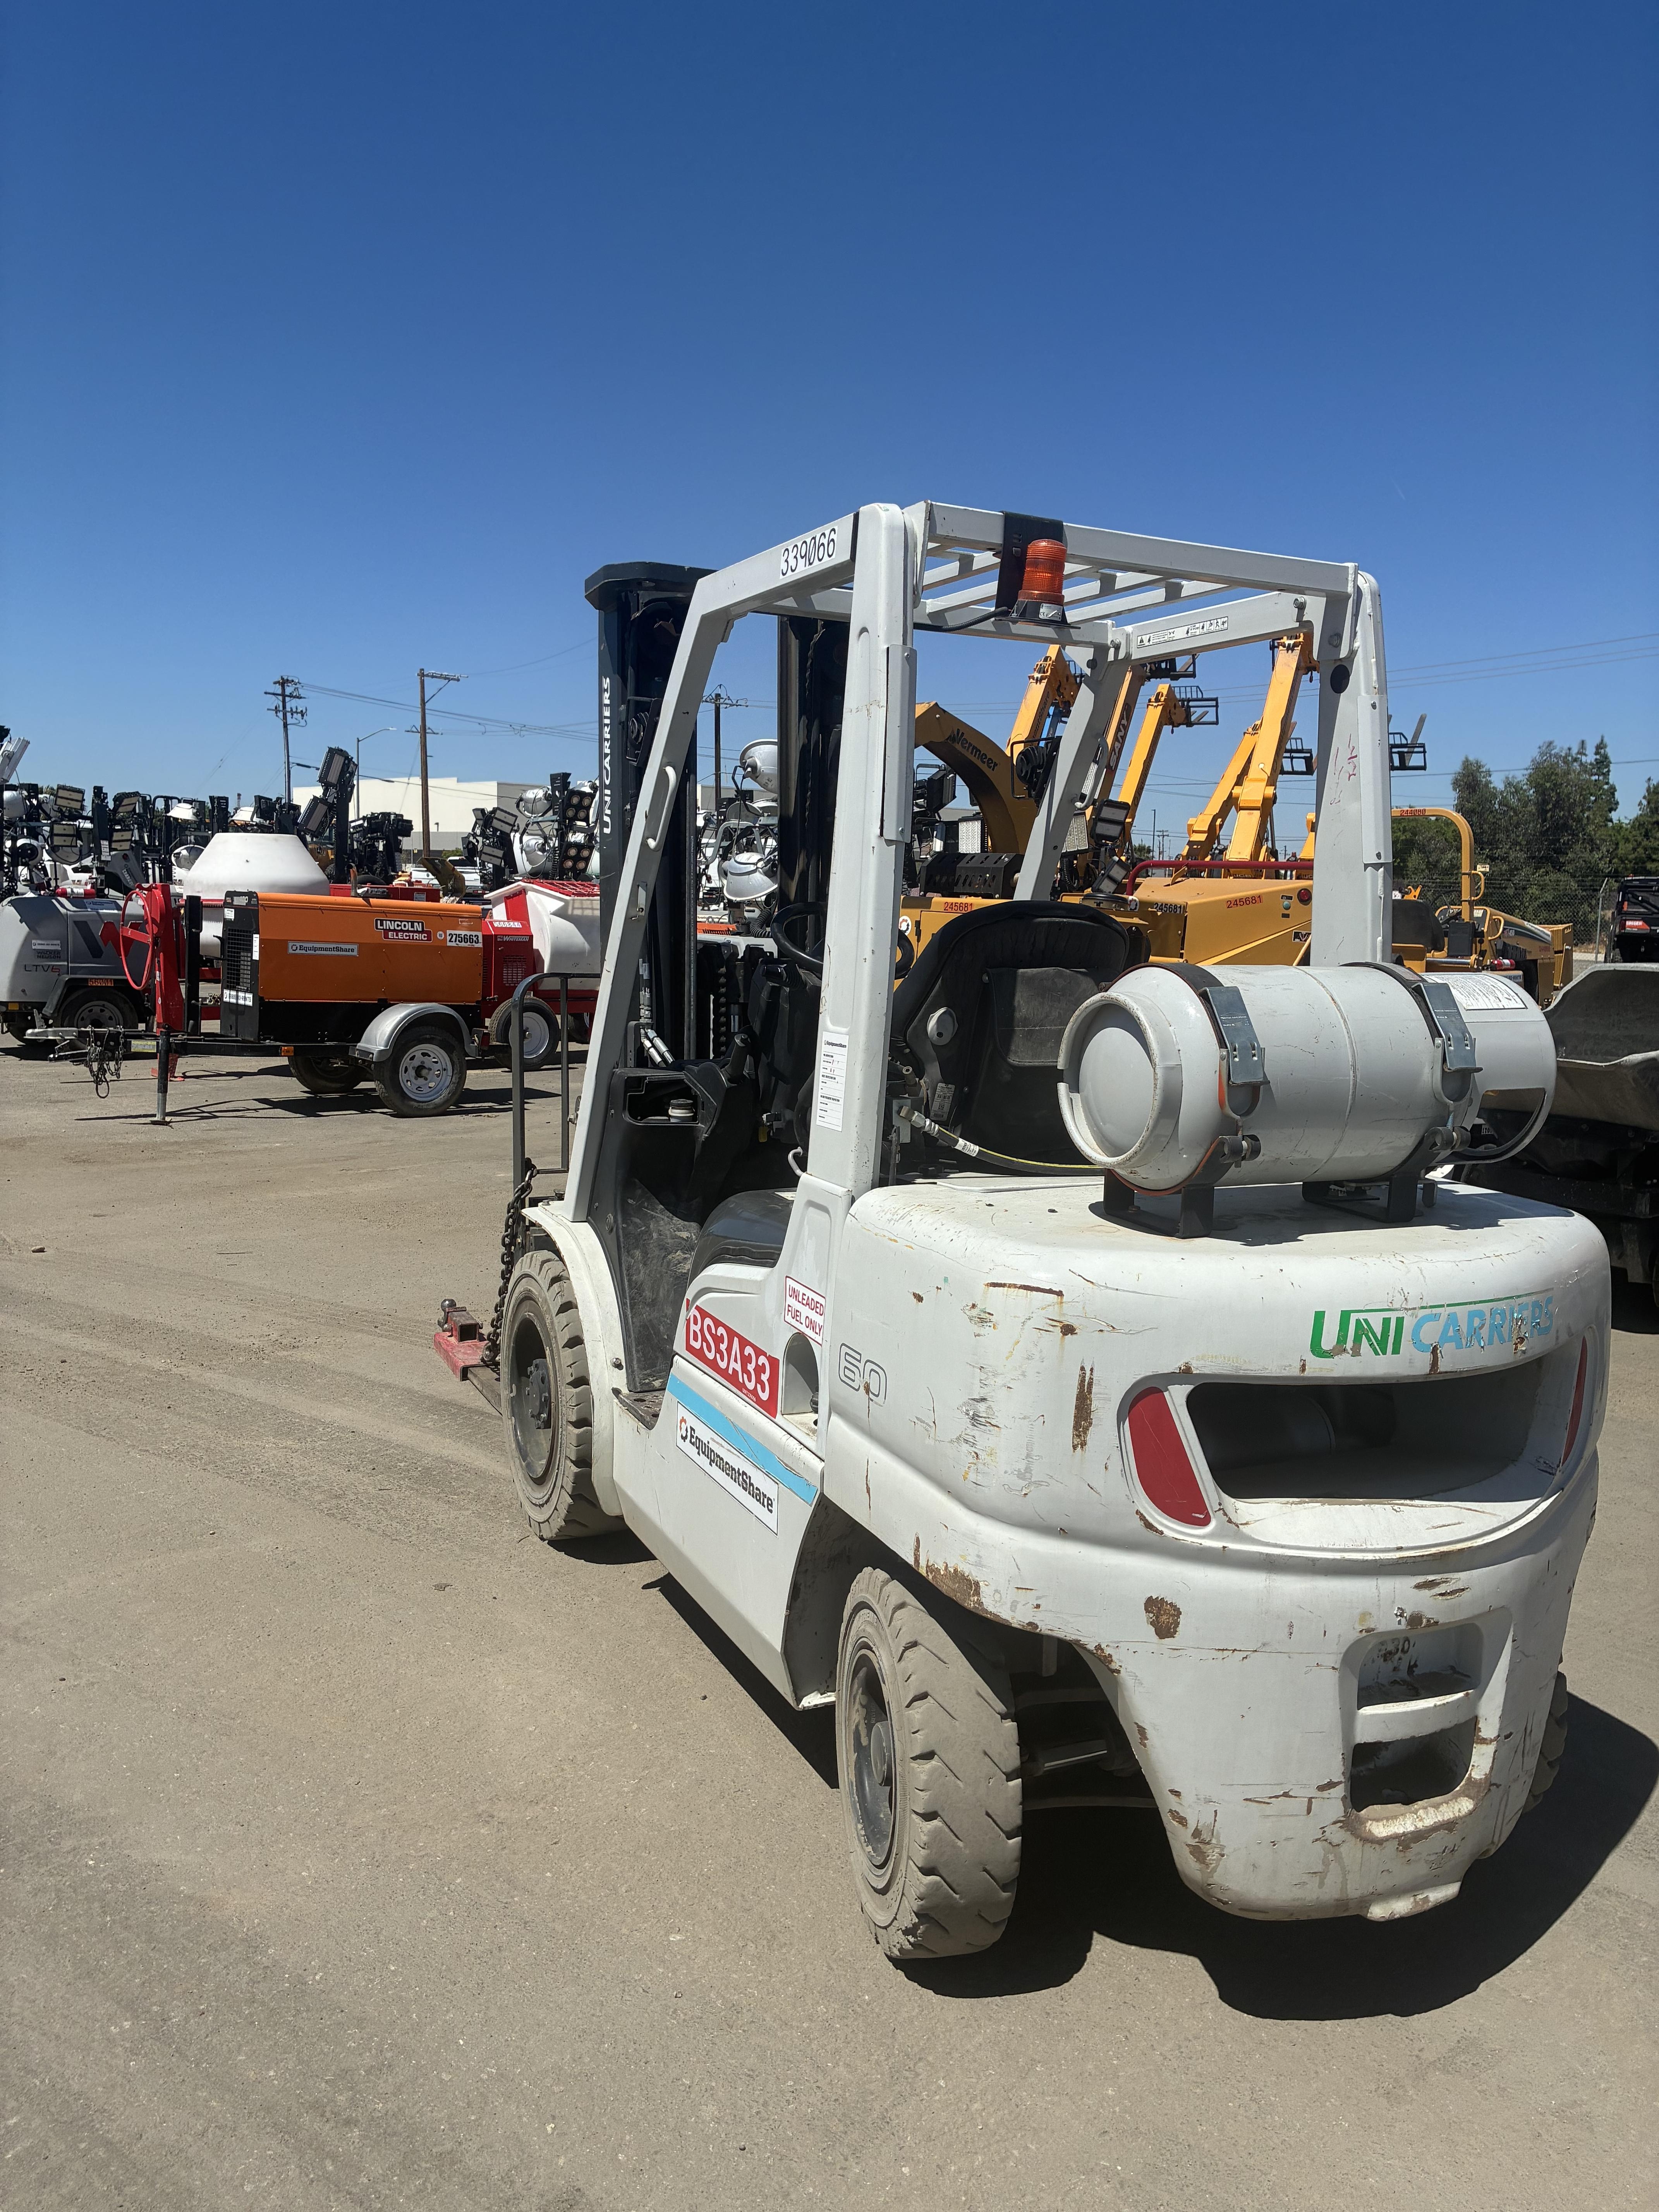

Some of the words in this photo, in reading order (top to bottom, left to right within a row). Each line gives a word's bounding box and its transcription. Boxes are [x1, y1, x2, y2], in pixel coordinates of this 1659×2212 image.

[1110, 708, 1127, 770] SANY
[956, 728, 998, 771] Vermeer
[944, 902, 972, 912] 245681
[1154, 902, 1182, 914] 245681
[1226, 895, 1262, 908] 245681
[377, 920, 422, 931] LINCOLN
[388, 932, 428, 941] ELECTRIC
[448, 933, 479, 944] 275663
[299, 945, 355, 953] EquipmentShare
[25, 964, 60, 972] LTV6
[788, 1284, 824, 1316] UNLEADED
[787, 1304, 803, 1325] FUEL
[805, 1316, 823, 1336] ONLY
[689, 1307, 770, 1401] BS3A33
[838, 1342, 887, 1407] 60
[689, 1425, 774, 1514] EquipmentShare
